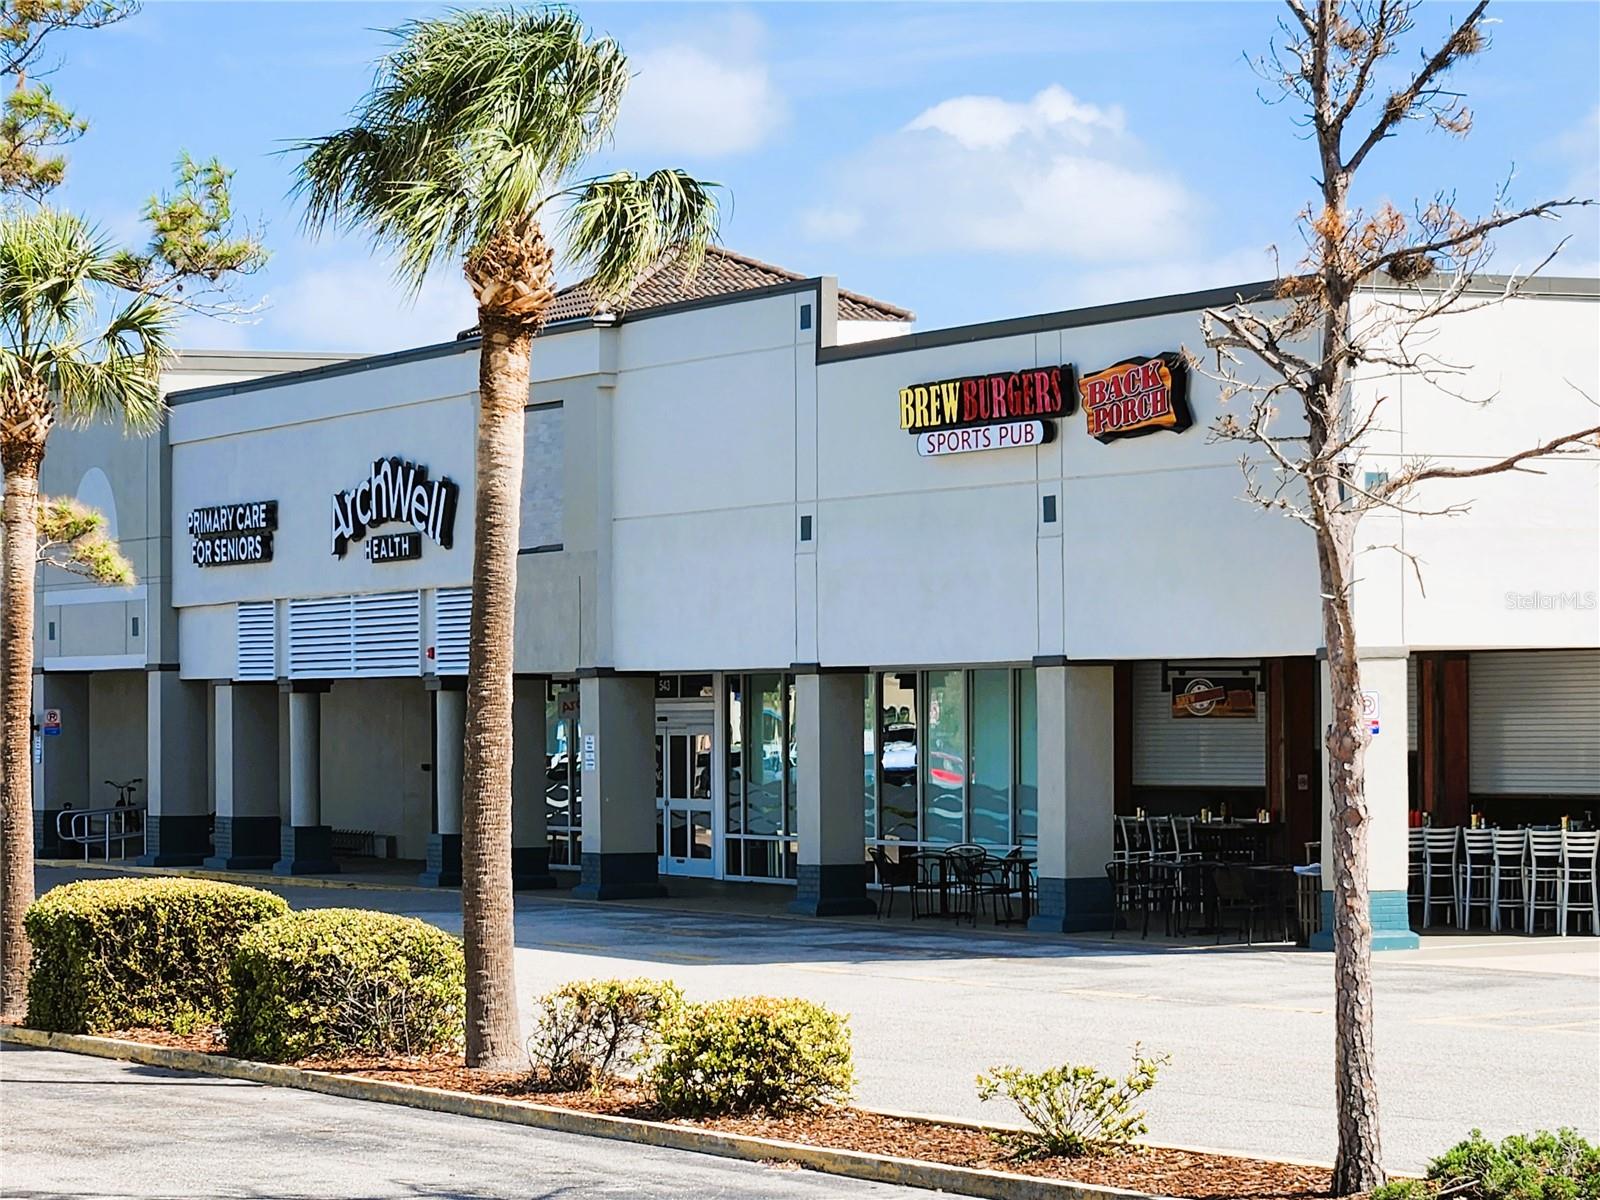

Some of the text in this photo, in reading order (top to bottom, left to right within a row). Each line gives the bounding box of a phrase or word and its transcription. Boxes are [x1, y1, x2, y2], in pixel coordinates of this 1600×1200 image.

[1087, 360, 1162, 407] BACK
[1093, 386, 1168, 434] PORCH
[926, 422, 1035, 454] SPORTS PUB
[188, 503, 267, 537] PRIMARY CARE
[331, 459, 447, 554] ArchWell
[192, 535, 262, 564] FOR SENIORS
[365, 536, 410, 560] HEALTH
[658, 679, 671, 692] 543
